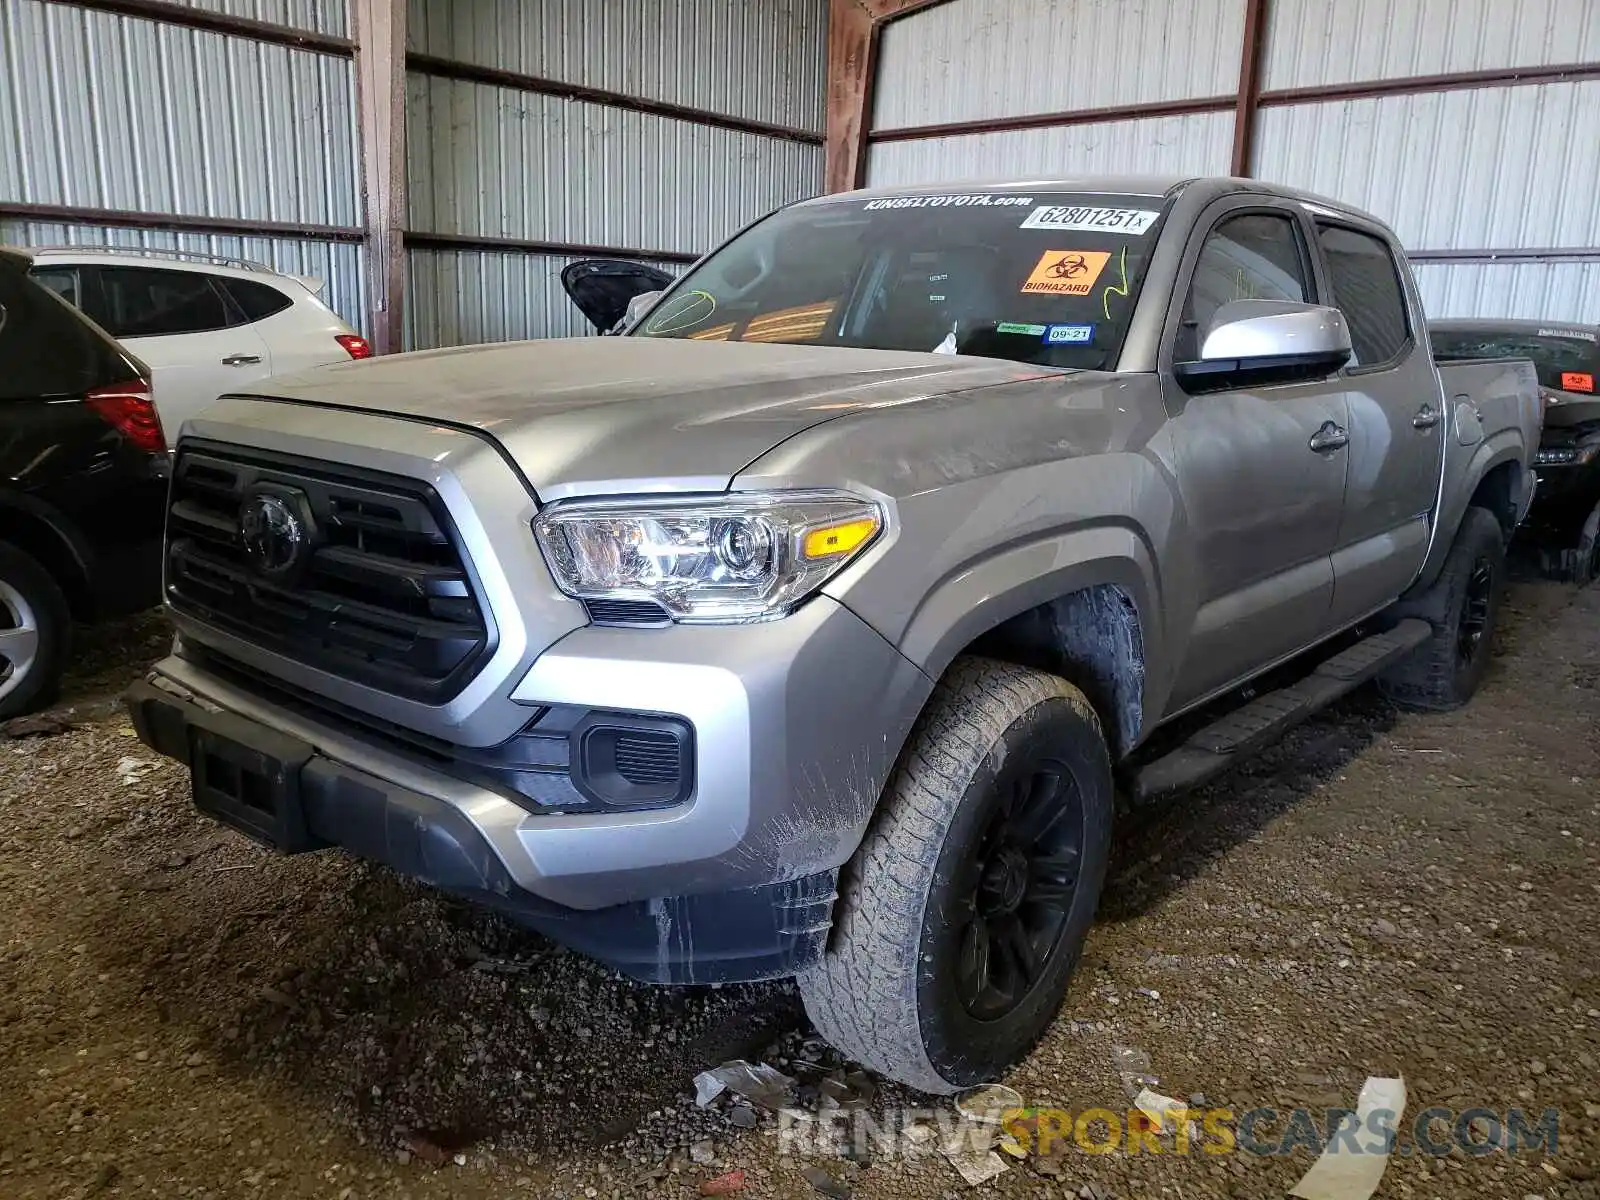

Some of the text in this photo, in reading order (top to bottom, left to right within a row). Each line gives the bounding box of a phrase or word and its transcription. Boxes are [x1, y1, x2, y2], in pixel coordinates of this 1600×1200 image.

[864, 195, 1033, 210] KINSELTOYOTA.com
[1040, 207, 1138, 228] 62801251
[1024, 282, 1090, 293] BIOHAZARD
